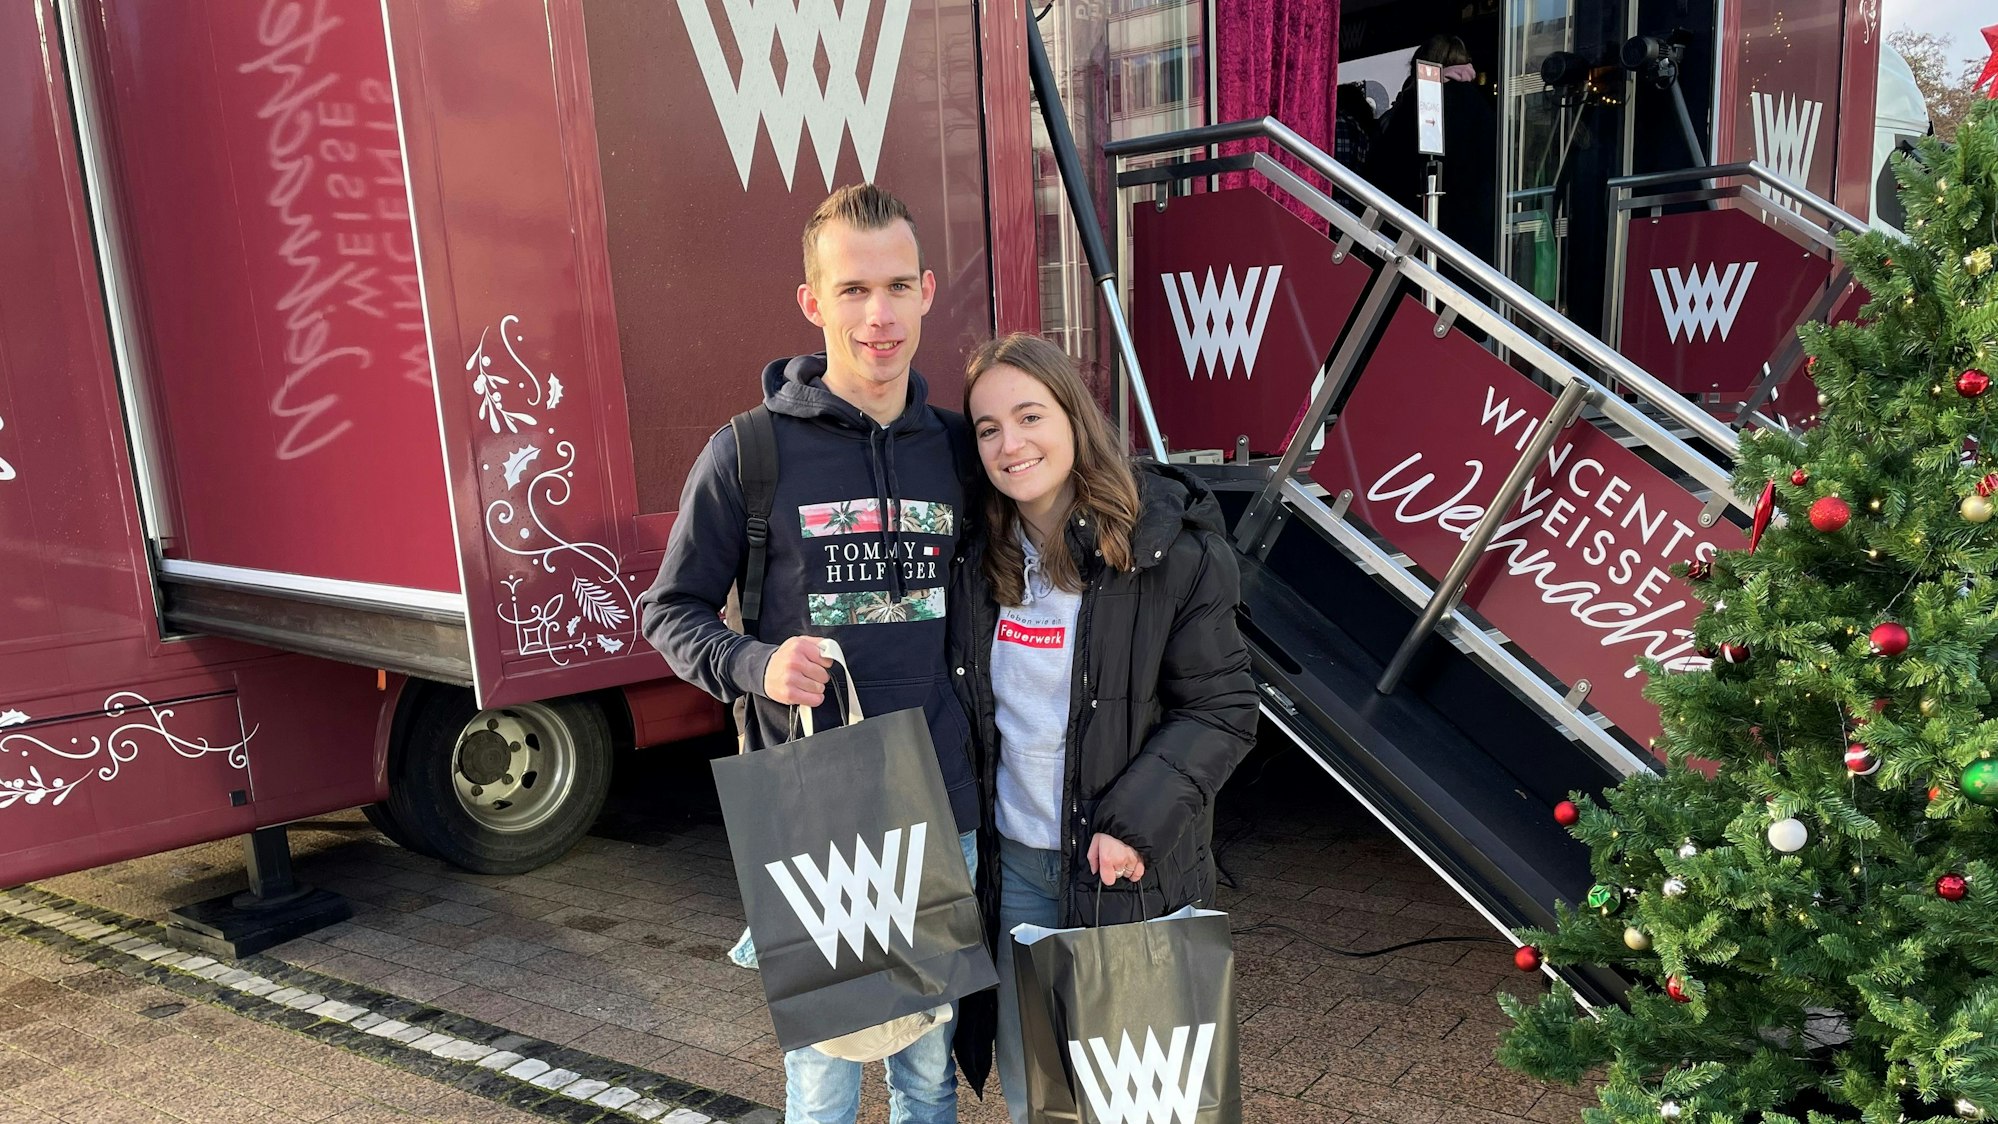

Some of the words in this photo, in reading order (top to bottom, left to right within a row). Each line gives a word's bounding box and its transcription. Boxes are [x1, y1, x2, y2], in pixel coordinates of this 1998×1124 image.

[824, 541, 916, 563] TOMMY
[826, 562, 936, 583] HILFGER
[1000, 624, 1062, 645] Feuerwerk
